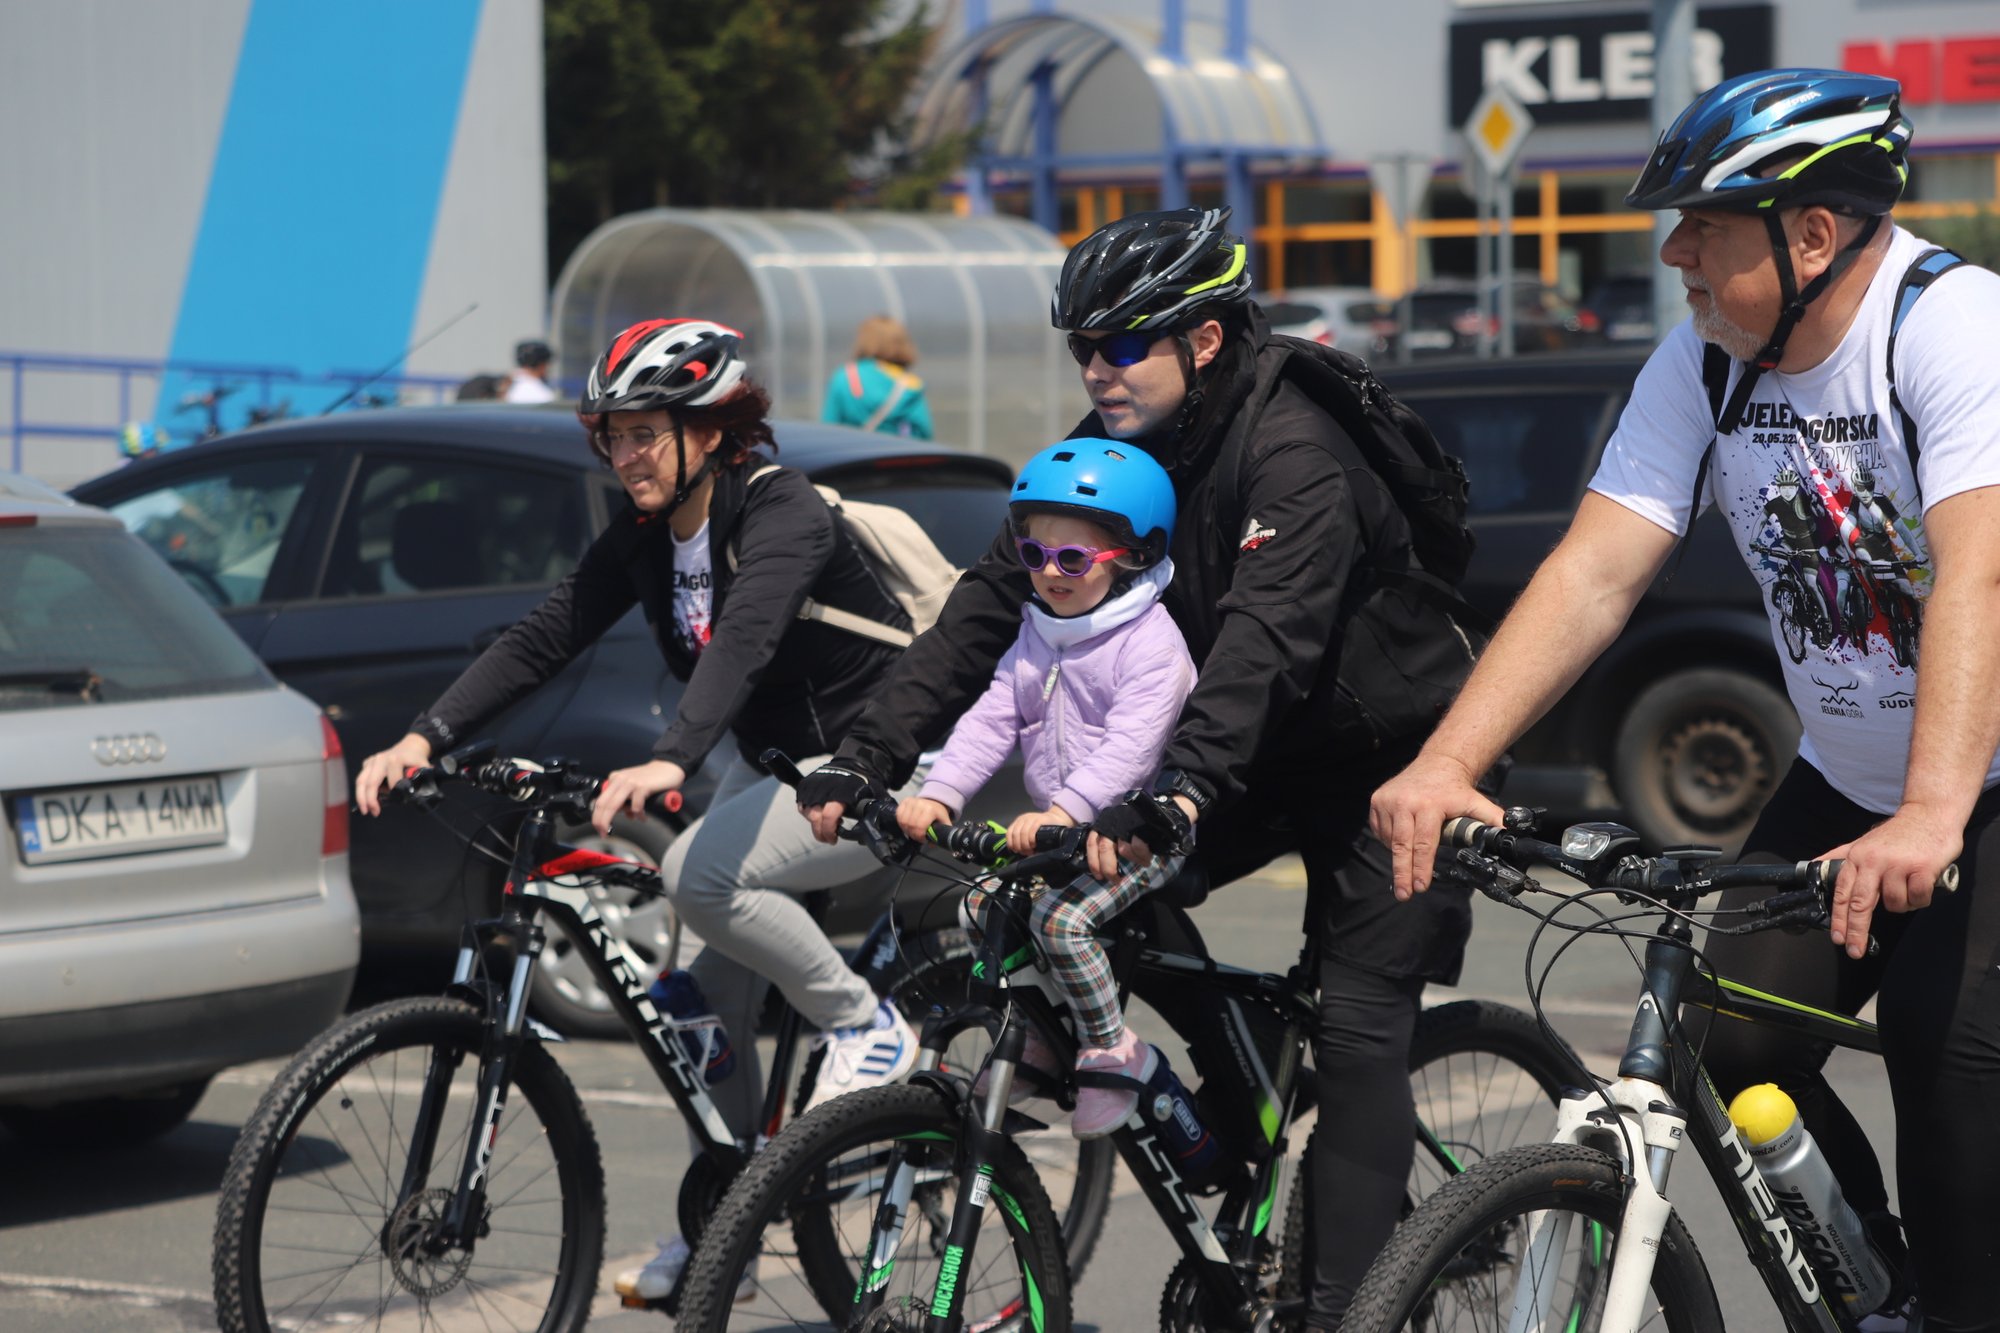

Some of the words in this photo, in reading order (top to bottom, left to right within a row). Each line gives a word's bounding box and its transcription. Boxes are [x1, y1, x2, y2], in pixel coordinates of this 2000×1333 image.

[43, 791, 125, 844] DKA
[136, 783, 217, 832] 14MW
[1826, 1222, 1852, 1267] NUTRITION
[930, 1244, 965, 1319] ROCKSHOX
[1847, 1264, 1869, 1293] SPORT
